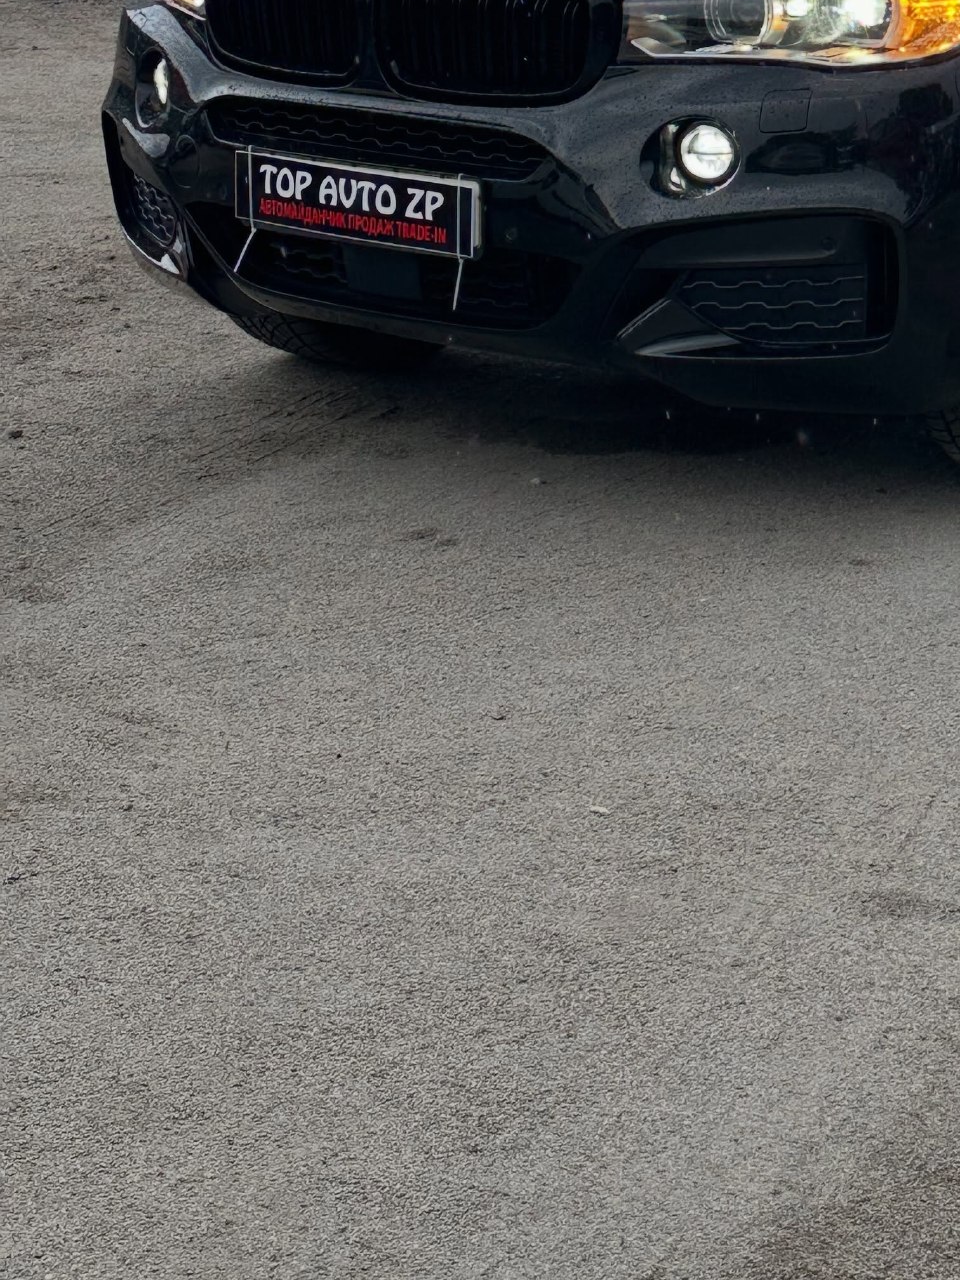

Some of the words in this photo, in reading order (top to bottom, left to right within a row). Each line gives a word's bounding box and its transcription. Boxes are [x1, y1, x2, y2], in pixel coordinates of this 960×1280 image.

[259, 164, 312, 201] TOP
[405, 188, 445, 221] ZP
[259, 198, 346, 227] АВТОМАЙДАНЧИК
[348, 217, 394, 237] ПРОДАЖ
